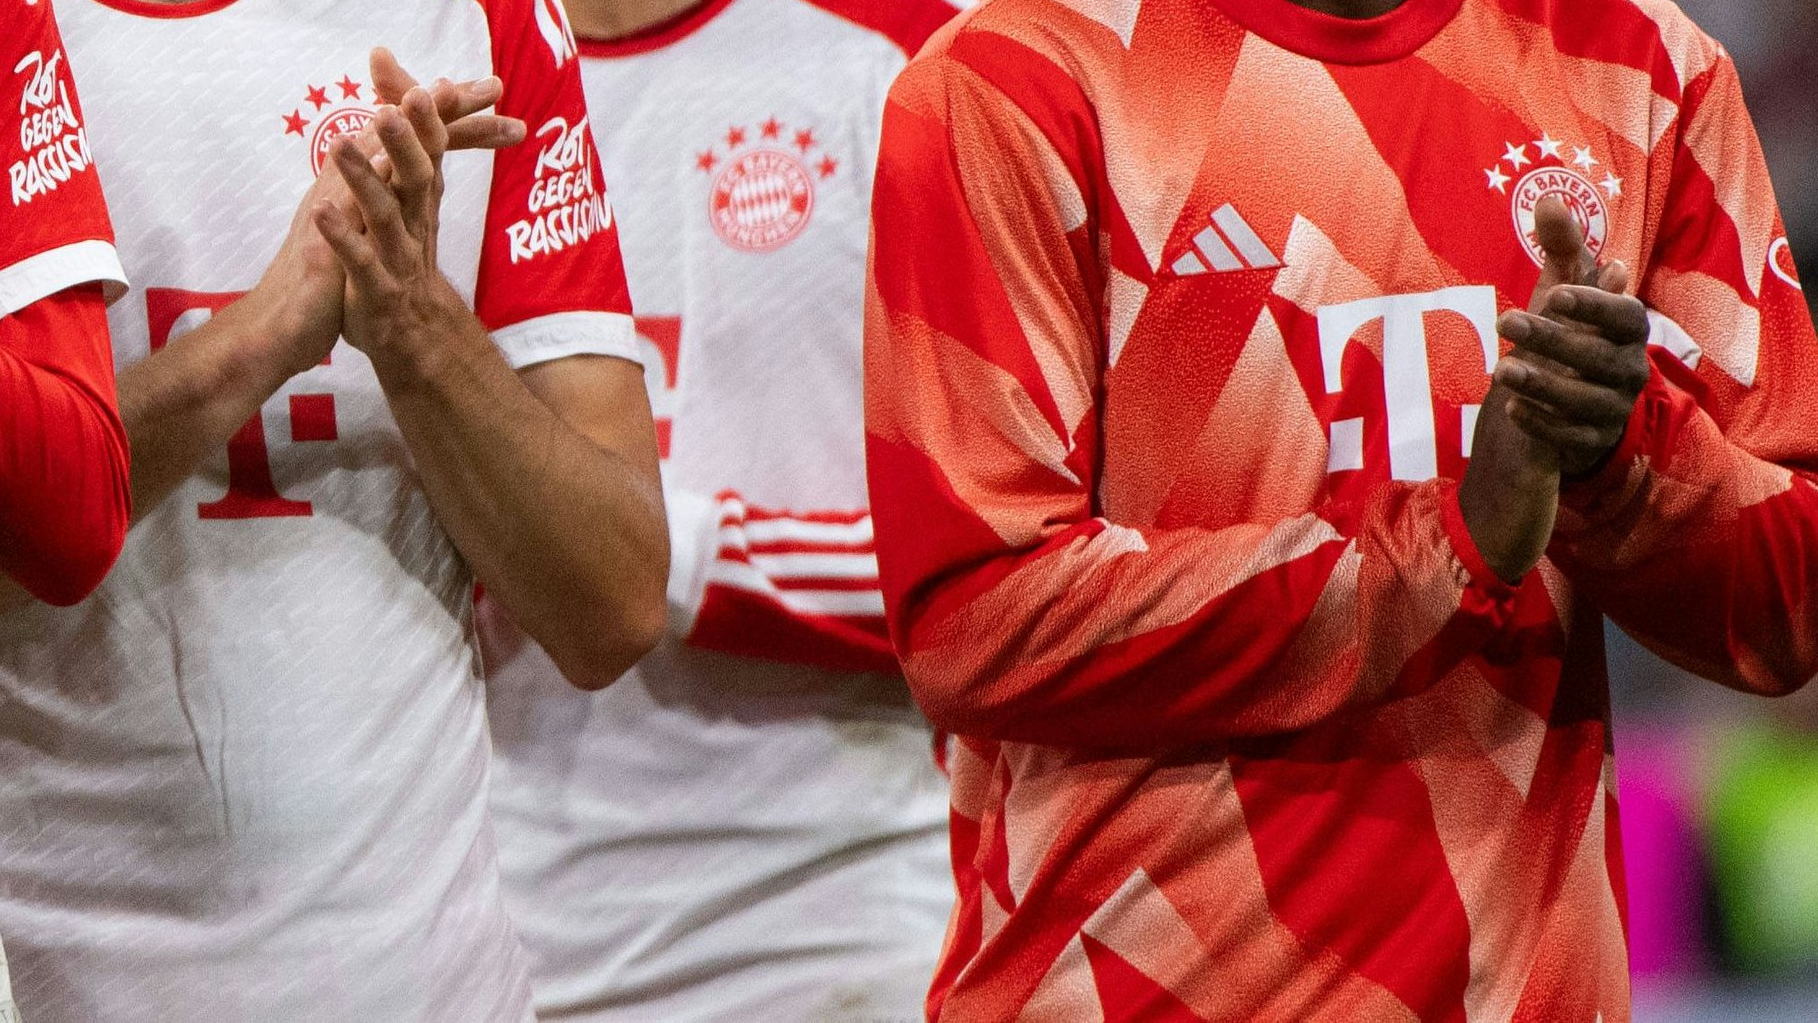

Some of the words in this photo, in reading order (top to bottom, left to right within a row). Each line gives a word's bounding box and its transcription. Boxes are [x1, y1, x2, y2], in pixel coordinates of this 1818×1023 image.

[20, 80, 78, 152] GEGEN
[335, 115, 371, 134] BAY
[528, 144, 593, 212] GEGEN
[1521, 188, 1536, 211] FC
[1535, 174, 1600, 217] BAYERN
[1316, 285, 1499, 482] T
